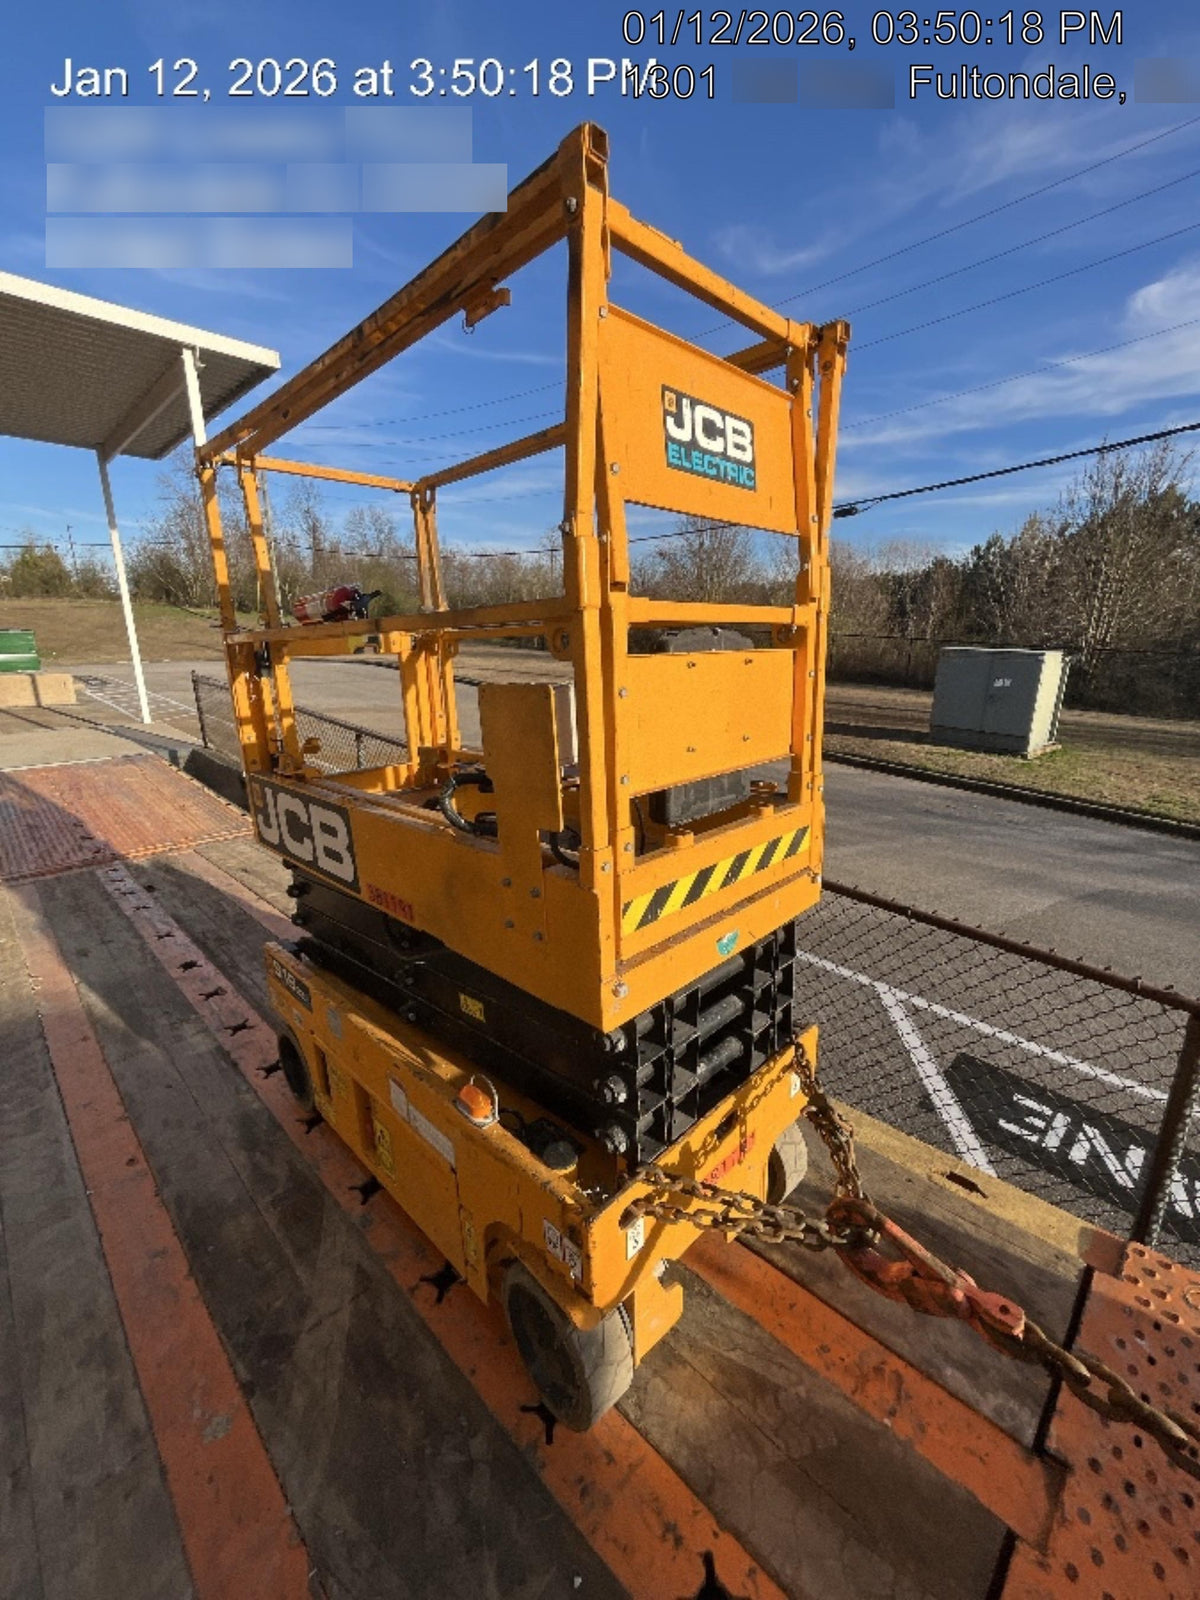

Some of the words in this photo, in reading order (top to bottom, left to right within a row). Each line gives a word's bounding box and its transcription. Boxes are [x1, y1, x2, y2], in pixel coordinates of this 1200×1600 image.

[665, 397, 753, 463] JCB
[667, 441, 755, 487] ELECTRIC
[257, 786, 354, 883] JCB
